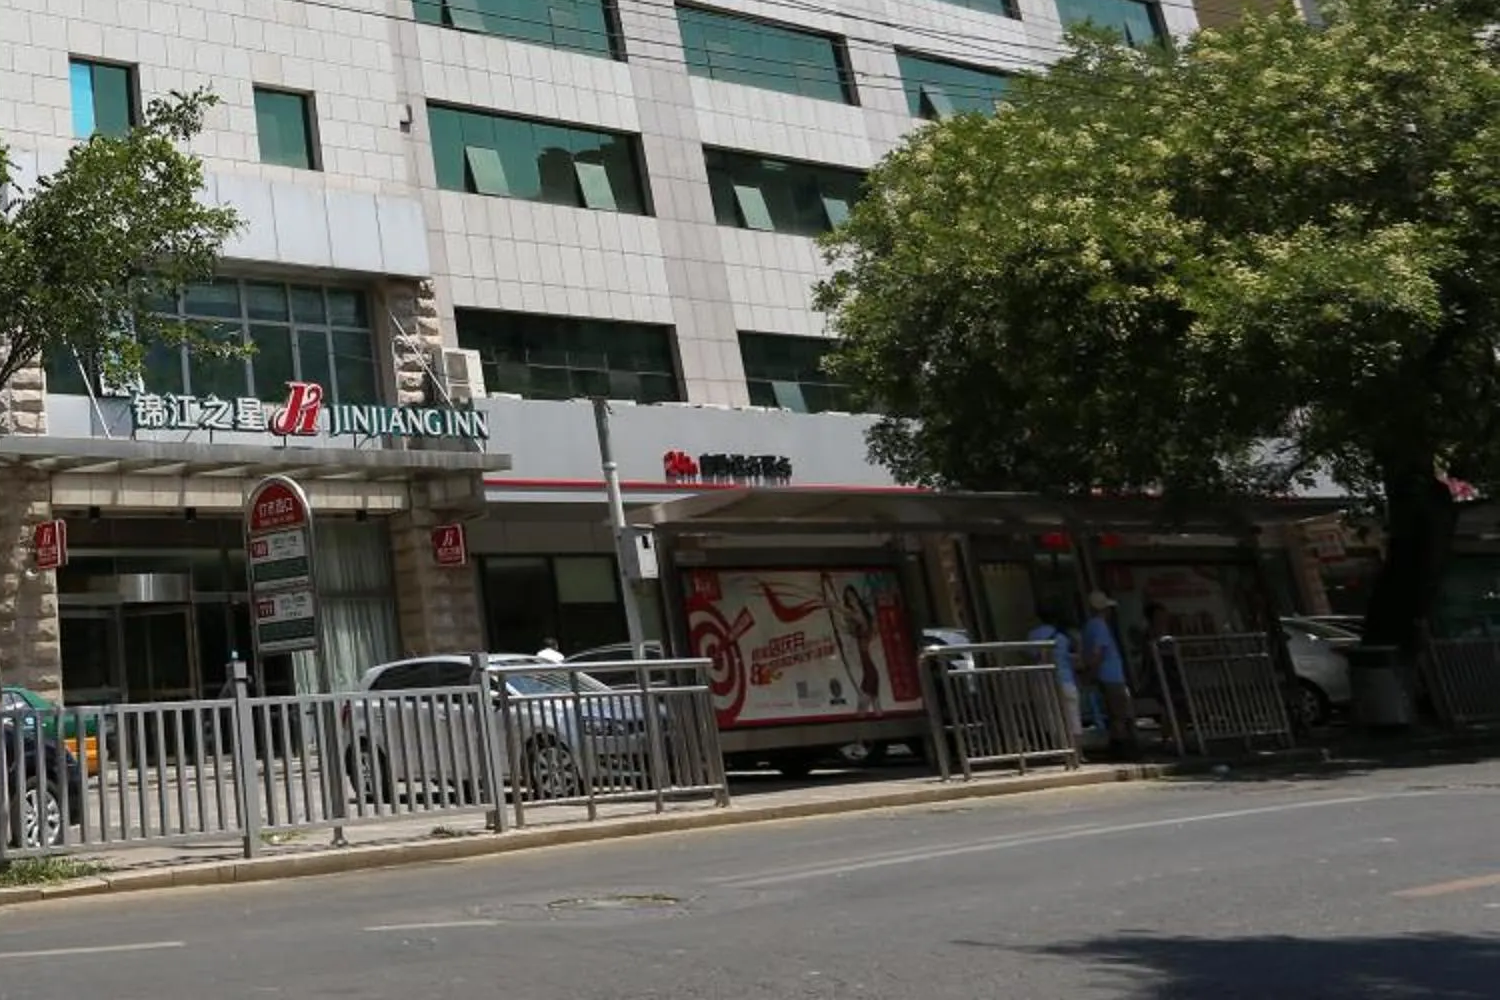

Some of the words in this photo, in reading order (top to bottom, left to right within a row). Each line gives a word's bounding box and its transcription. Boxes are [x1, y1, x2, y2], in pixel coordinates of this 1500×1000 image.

[133, 392, 266, 430] 锦江之星
[329, 404, 444, 437] JINJIANG
[446, 409, 490, 438] INN
